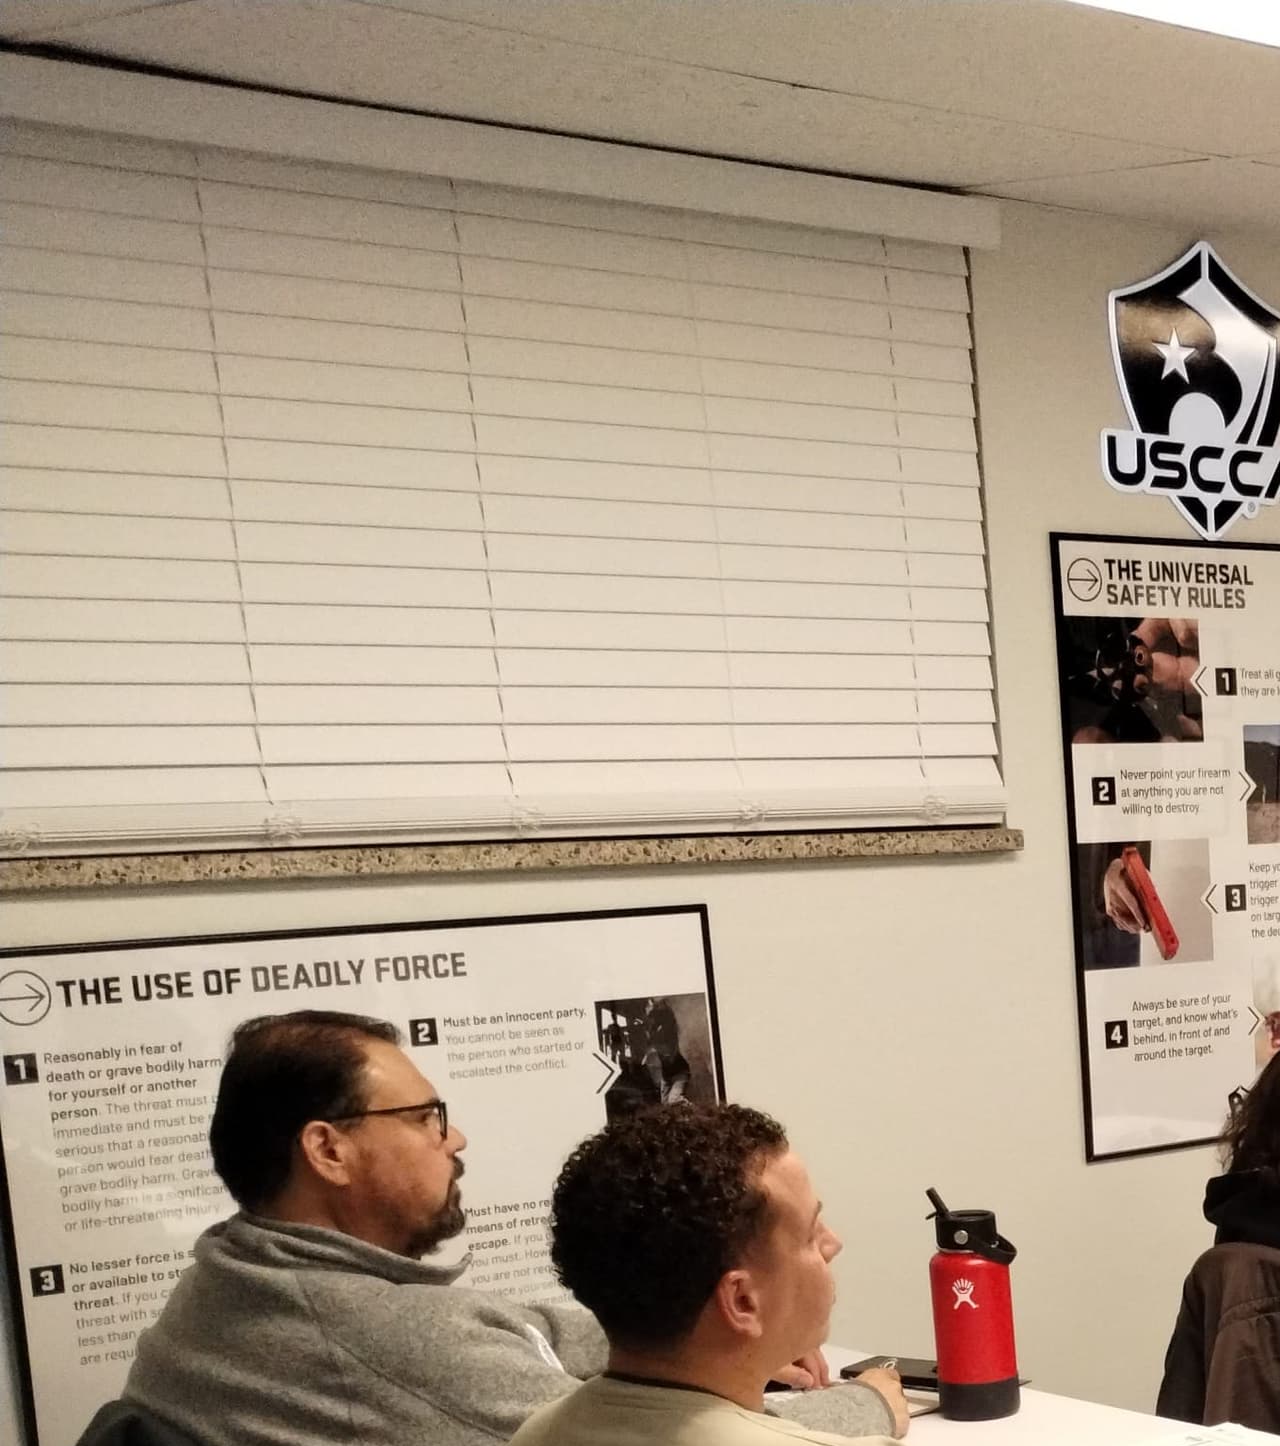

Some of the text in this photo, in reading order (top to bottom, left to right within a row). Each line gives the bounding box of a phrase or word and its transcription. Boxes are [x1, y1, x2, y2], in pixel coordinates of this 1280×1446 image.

[1104, 559, 1254, 586] THE UNIVERSAL
[1106, 585, 1246, 609] SAFETY RULES
[1221, 672, 1231, 692] 1
[1240, 668, 1262, 680] Treat
[1263, 669, 1274, 680] all
[1240, 684, 1259, 699] they
[1260, 687, 1275, 696] are
[1120, 767, 1231, 782] Never point your firearm
[1098, 781, 1110, 801] 2
[1121, 783, 1224, 799] at anything you are not
[1121, 802, 1201, 817] willing to destroy.
[1249, 862, 1271, 874] Keep
[1250, 877, 1277, 891] trigger
[1231, 889, 1241, 907] 3
[55, 951, 467, 1007] THE USE OF DEADLY FORCE
[1132, 993, 1231, 1012] Always be sure of your
[443, 1016, 470, 1027] Must
[472, 1016, 486, 1025] be
[505, 1010, 553, 1022] innocent
[555, 1008, 587, 1020] party.
[1132, 1007, 1238, 1030] target, and know what's
[417, 1023, 431, 1042] 2
[1110, 1025, 1123, 1044] 4
[1133, 1024, 1230, 1045] behind, in front of and
[43, 1041, 183, 1064] Reasonably in fear of
[1134, 1042, 1214, 1061] around the target.
[14, 1058, 27, 1080] 1
[45, 1058, 222, 1083] death or grave bodily harm
[48, 1078, 197, 1102] for yourself or another
[51, 1093, 207, 1122] person. The threat must
[464, 1205, 491, 1217] Must
[493, 1203, 520, 1213] have
[522, 1201, 536, 1210] no
[466, 1220, 517, 1235] means of
[69, 1251, 184, 1274] No lesser force is
[40, 1270, 55, 1291] 3
[72, 1271, 165, 1293] or available to
[74, 1293, 158, 1311] threat. If you
